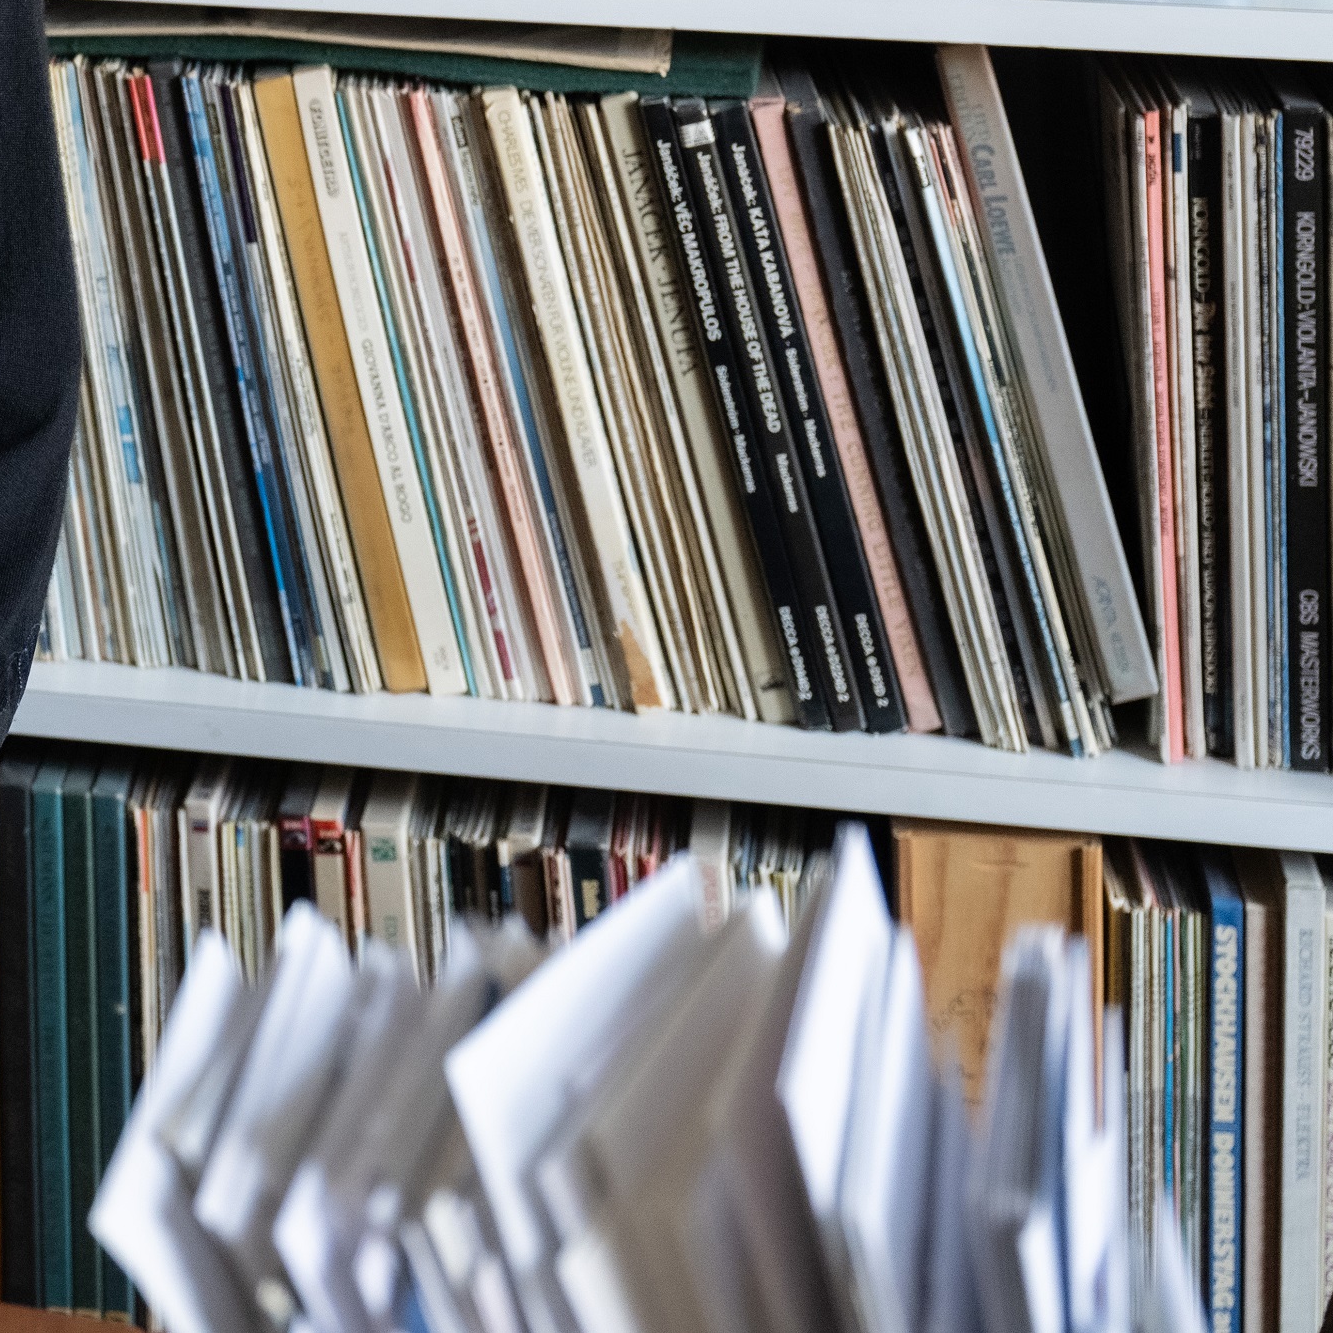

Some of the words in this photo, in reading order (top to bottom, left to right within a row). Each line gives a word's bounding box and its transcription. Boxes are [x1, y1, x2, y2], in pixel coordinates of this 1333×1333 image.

[655, 139, 684, 201] Janáček:
[695, 151, 723, 213] Janáček:
[971, 143, 999, 192] CARL
[1293, 127, 1315, 182] 79229
[672, 201, 697, 234] VĚC
[713, 213, 738, 258] FROM
[729, 142, 754, 205] Janáček:
[755, 248, 794, 340] KABANOVÁ
[980, 193, 1016, 257] LOEWE
[679, 233, 723, 342] MAKROPULOS
[723, 256, 744, 285] THE
[730, 284, 759, 337] HOUSE
[749, 360, 771, 390] THE
[359, 338, 386, 411] GIOVANNA
[395, 485, 413, 524] ROGO
[755, 389, 781, 433] DEAD
[1297, 588, 1320, 626] CBS
[1299, 631, 1320, 760] MASTERWORKS
[1212, 922, 1240, 1126] STOCKHAUSEN
[1212, 1130, 1242, 1312] DONNERSTAG
